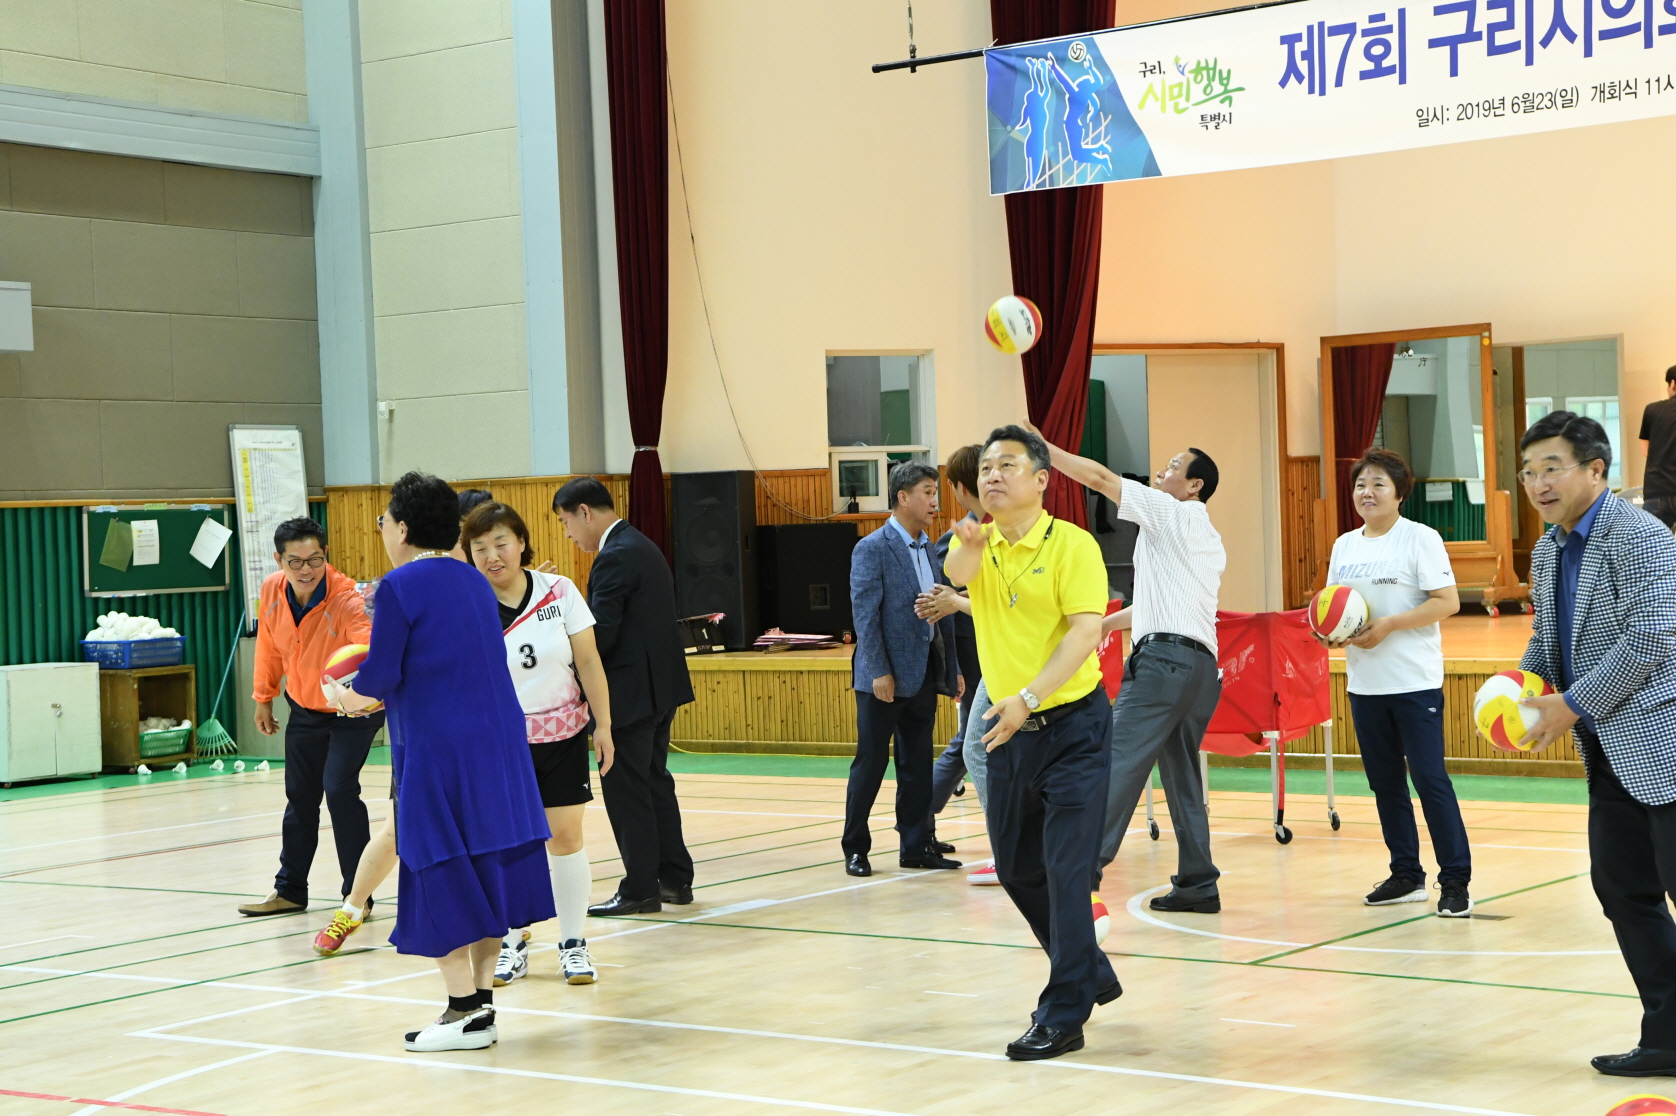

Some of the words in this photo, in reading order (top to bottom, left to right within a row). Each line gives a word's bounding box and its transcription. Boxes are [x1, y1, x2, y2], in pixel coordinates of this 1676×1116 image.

[1279, 8, 1407, 96] 제7회
[1139, 60, 1166, 78] 구리,
[1416, 104, 1450, 127] 일시:
[1457, 97, 1505, 121] 2019년
[1511, 86, 1579, 114] 6월23(일)
[1591, 78, 1638, 103] 개회식
[1199, 112, 1232, 130] 특별시
[1371, 577, 1398, 586] RUNNING
[536, 605, 562, 622] GURI
[518, 643, 538, 670] 3
